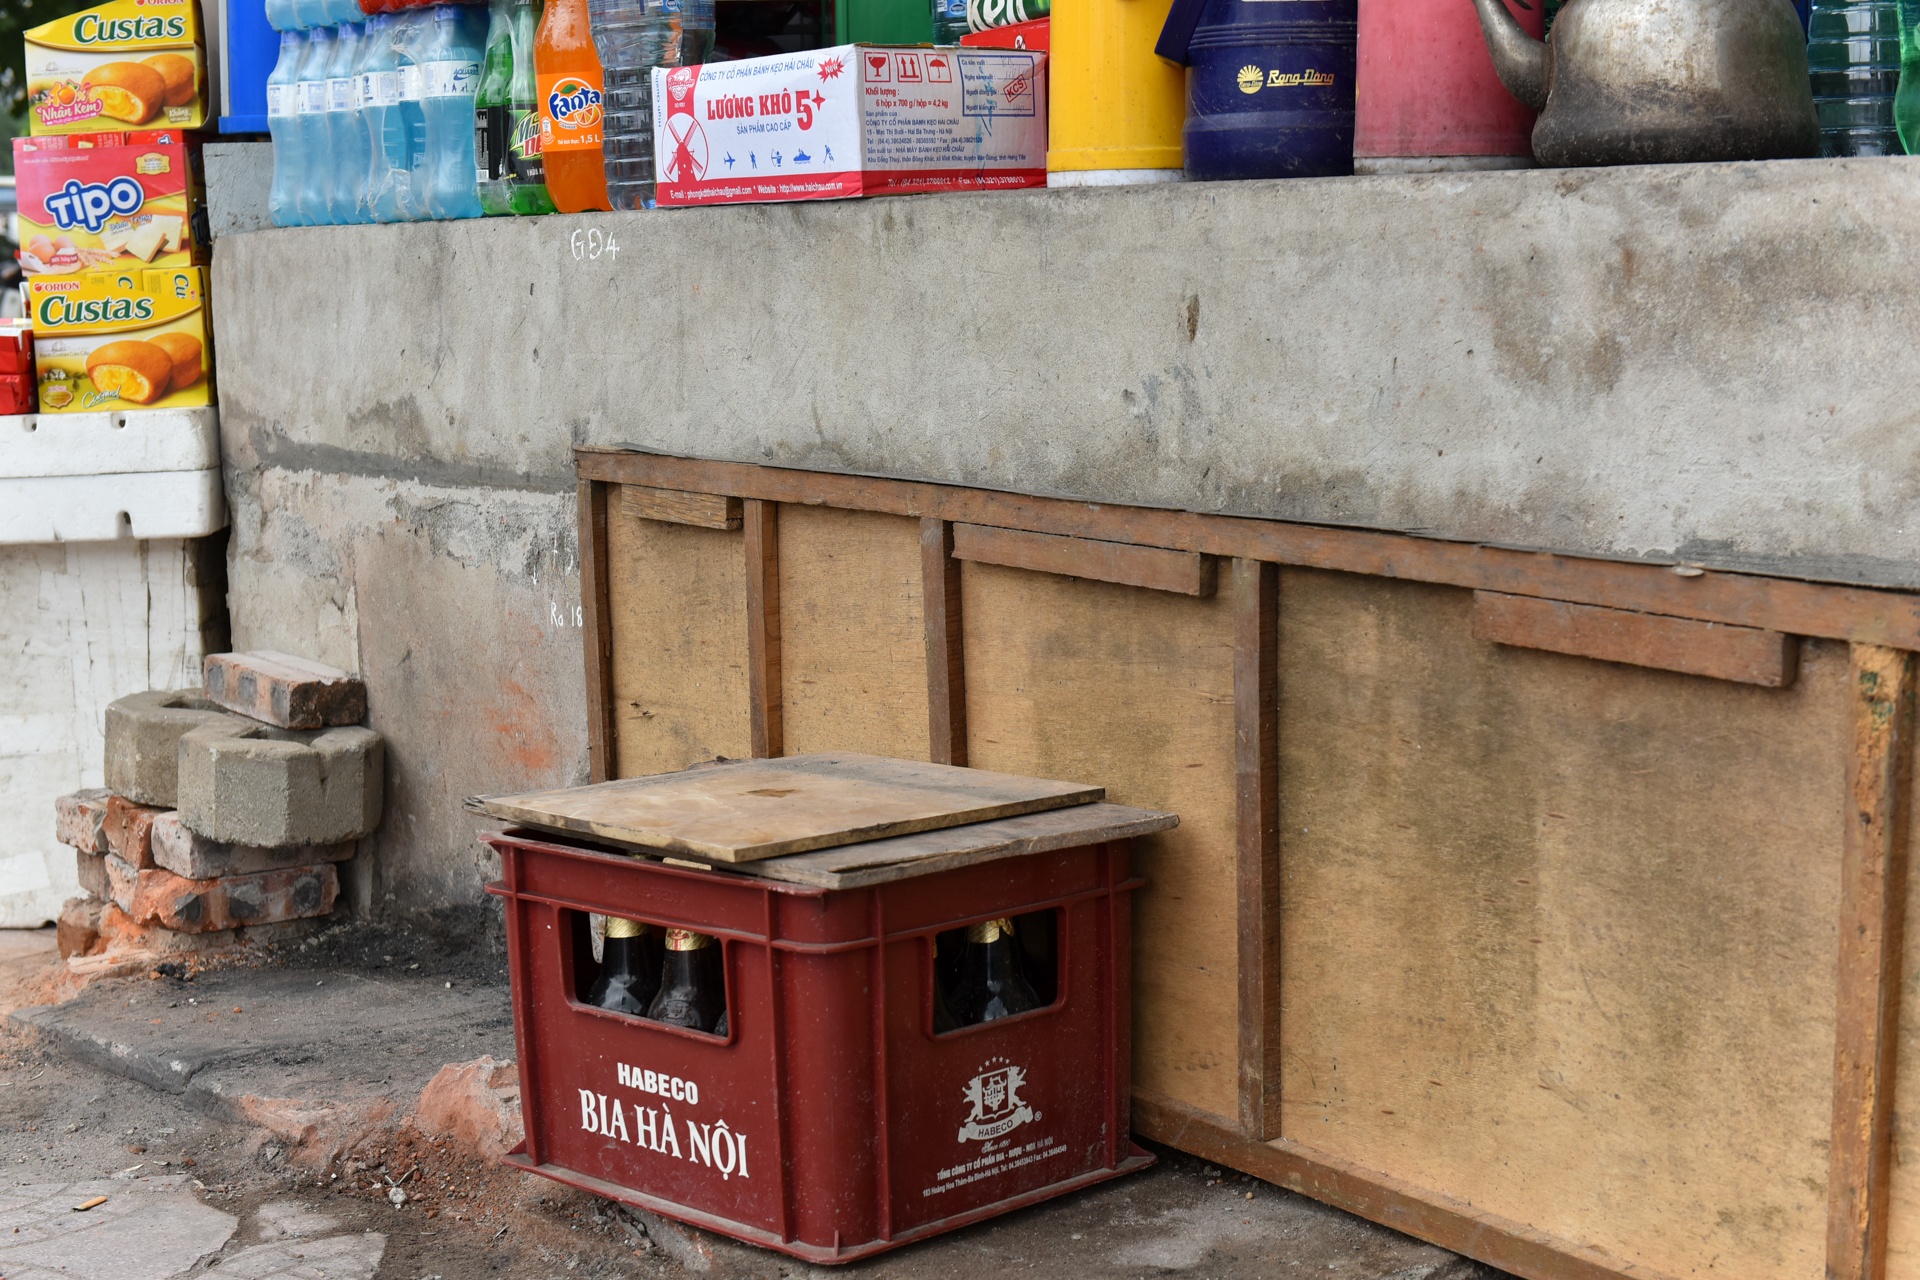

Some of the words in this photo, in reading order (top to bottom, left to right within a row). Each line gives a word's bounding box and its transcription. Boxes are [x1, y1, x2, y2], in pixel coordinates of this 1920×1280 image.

[73, 14, 186, 44] Custas
[718, 70, 726, 80] TY
[753, 65, 770, 76] BÁNH
[770, 62, 783, 76] KẸO
[1007, 79, 1025, 98] KCS
[41, 103, 73, 121] Nhân
[73, 101, 97, 116] Kem
[548, 86, 602, 121] Fanta
[707, 93, 754, 120] LƯƠNG
[759, 87, 792, 116] KHÔ
[898, 99, 908, 107] 700
[766, 121, 779, 132] CAO
[779, 118, 792, 131] CẤP
[580, 134, 593, 144] 1,5
[595, 134, 601, 142] L
[43, 282, 80, 292] ORION
[39, 294, 154, 326] Custas
[617, 1062, 699, 1105] HABECO
[577, 1088, 631, 1144] BIA
[633, 1102, 683, 1160] HÀ
[686, 1118, 750, 1181] NỘI
[978, 1119, 1014, 1138] HABECO
[966, 1161, 973, 1172] TY
